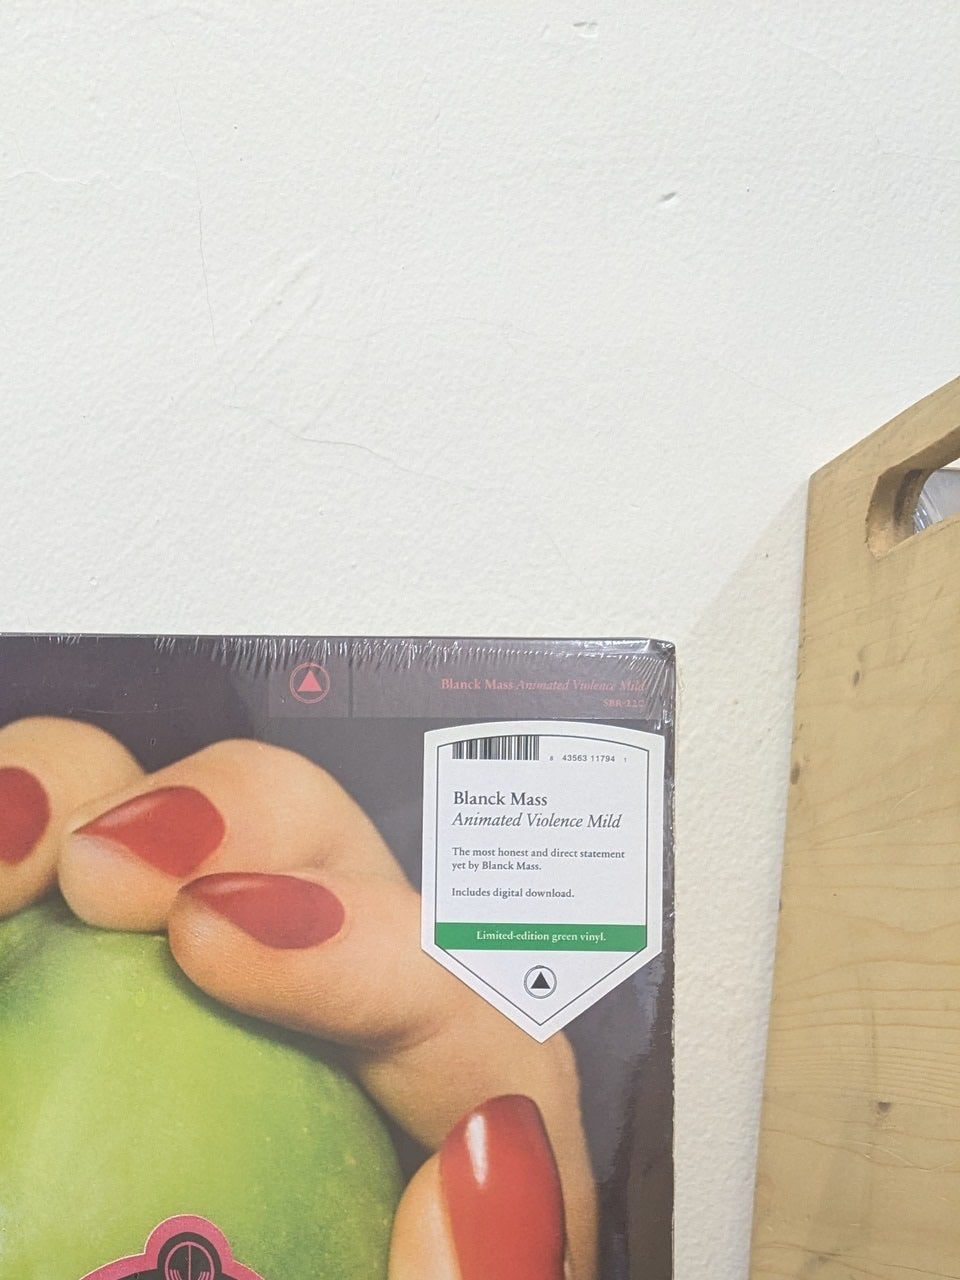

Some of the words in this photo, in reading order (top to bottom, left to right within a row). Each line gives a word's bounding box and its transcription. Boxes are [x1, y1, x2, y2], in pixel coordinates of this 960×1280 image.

[441, 678, 481, 690] Blanck
[485, 679, 514, 690] Mass
[453, 791, 506, 806] Blanck
[511, 792, 548, 806] Mass
[451, 812, 523, 827] Animated
[527, 814, 583, 828] Violence
[587, 814, 622, 829] Mild
[452, 847, 470, 856] The
[472, 848, 495, 857] most
[498, 848, 528, 857] honest
[531, 849, 548, 857] and
[550, 848, 577, 858] direct
[580, 850, 625, 858] statement
[452, 862, 466, 872] yet
[468, 860, 479, 872] by
[482, 861, 514, 870] Blanck
[516, 862, 541, 870] Mass.
[451, 888, 490, 897] Includes
[493, 888, 523, 899] digital
[525, 889, 574, 898] download.
[476, 931, 549, 940] Limited-edition
[551, 933, 578, 943] green
[580, 932, 606, 943] vinyl.
